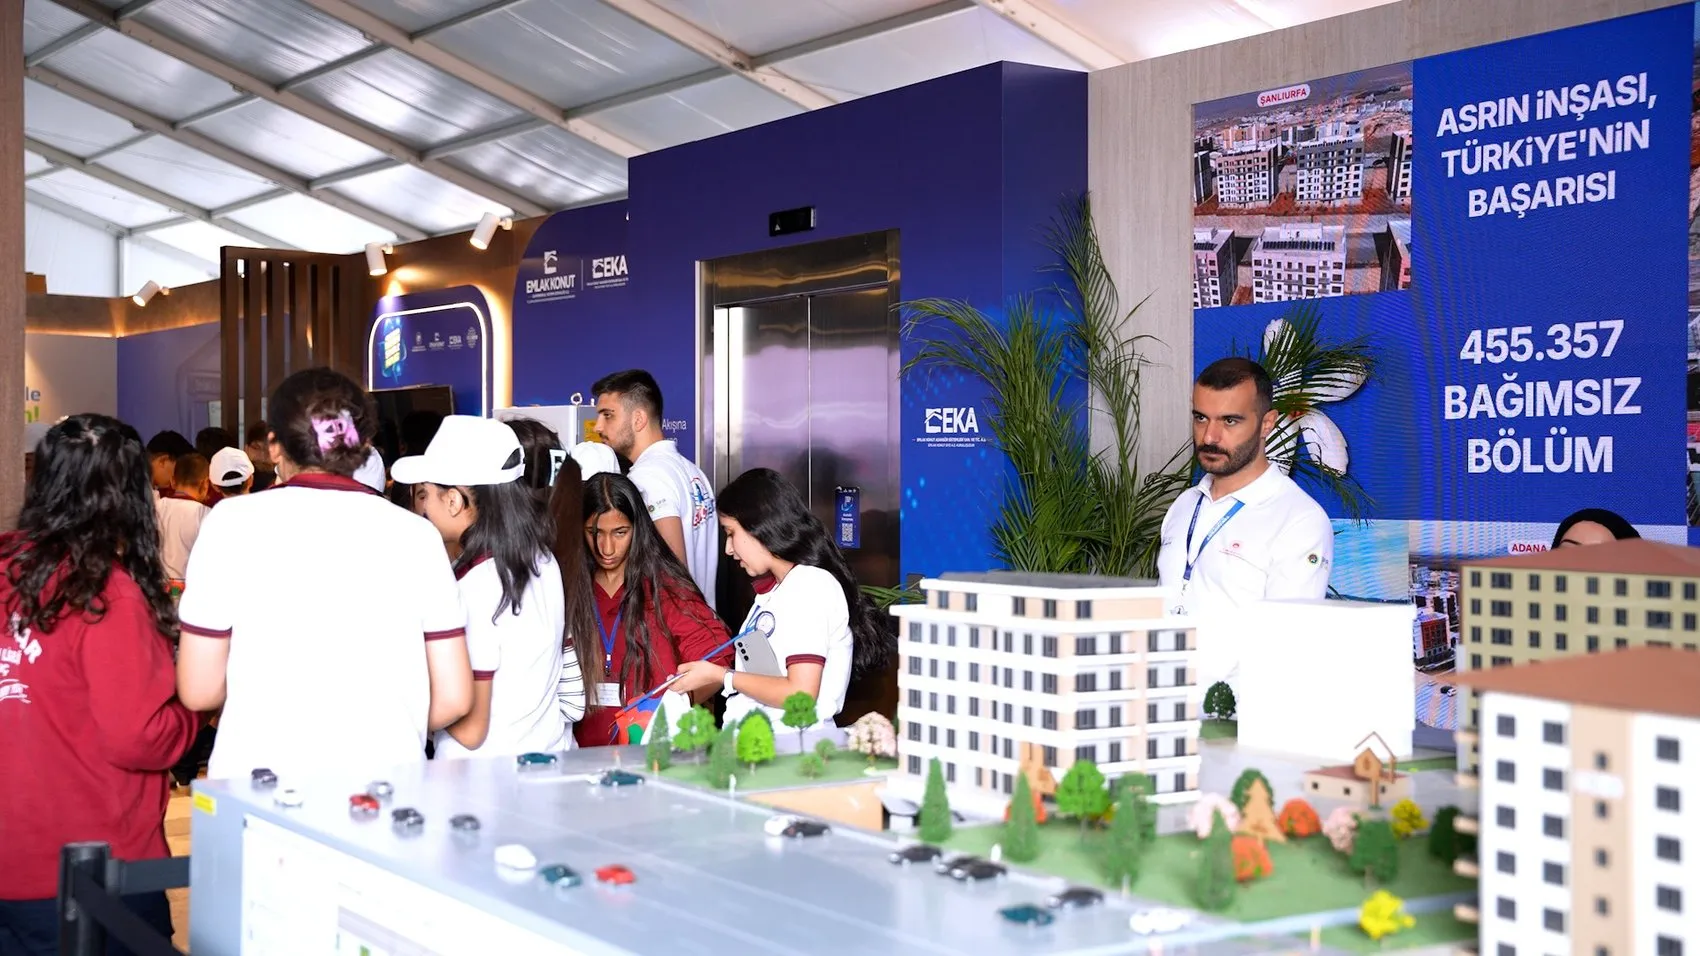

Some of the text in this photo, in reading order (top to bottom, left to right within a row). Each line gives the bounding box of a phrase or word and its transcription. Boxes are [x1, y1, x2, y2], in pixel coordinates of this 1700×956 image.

[1260, 87, 1307, 106] ŞANLIURFA
[1436, 93, 1530, 137] ASRIN
[1468, 170, 1616, 218] BAŞARISI
[603, 255, 628, 277] EKA
[1459, 319, 1625, 365] 455.357
[1444, 372, 1642, 420] BAĞIMSIZ
[942, 407, 979, 433] EKA
[1467, 426, 1613, 473] BÖLÜM
[1511, 543, 1547, 553] ADANA
